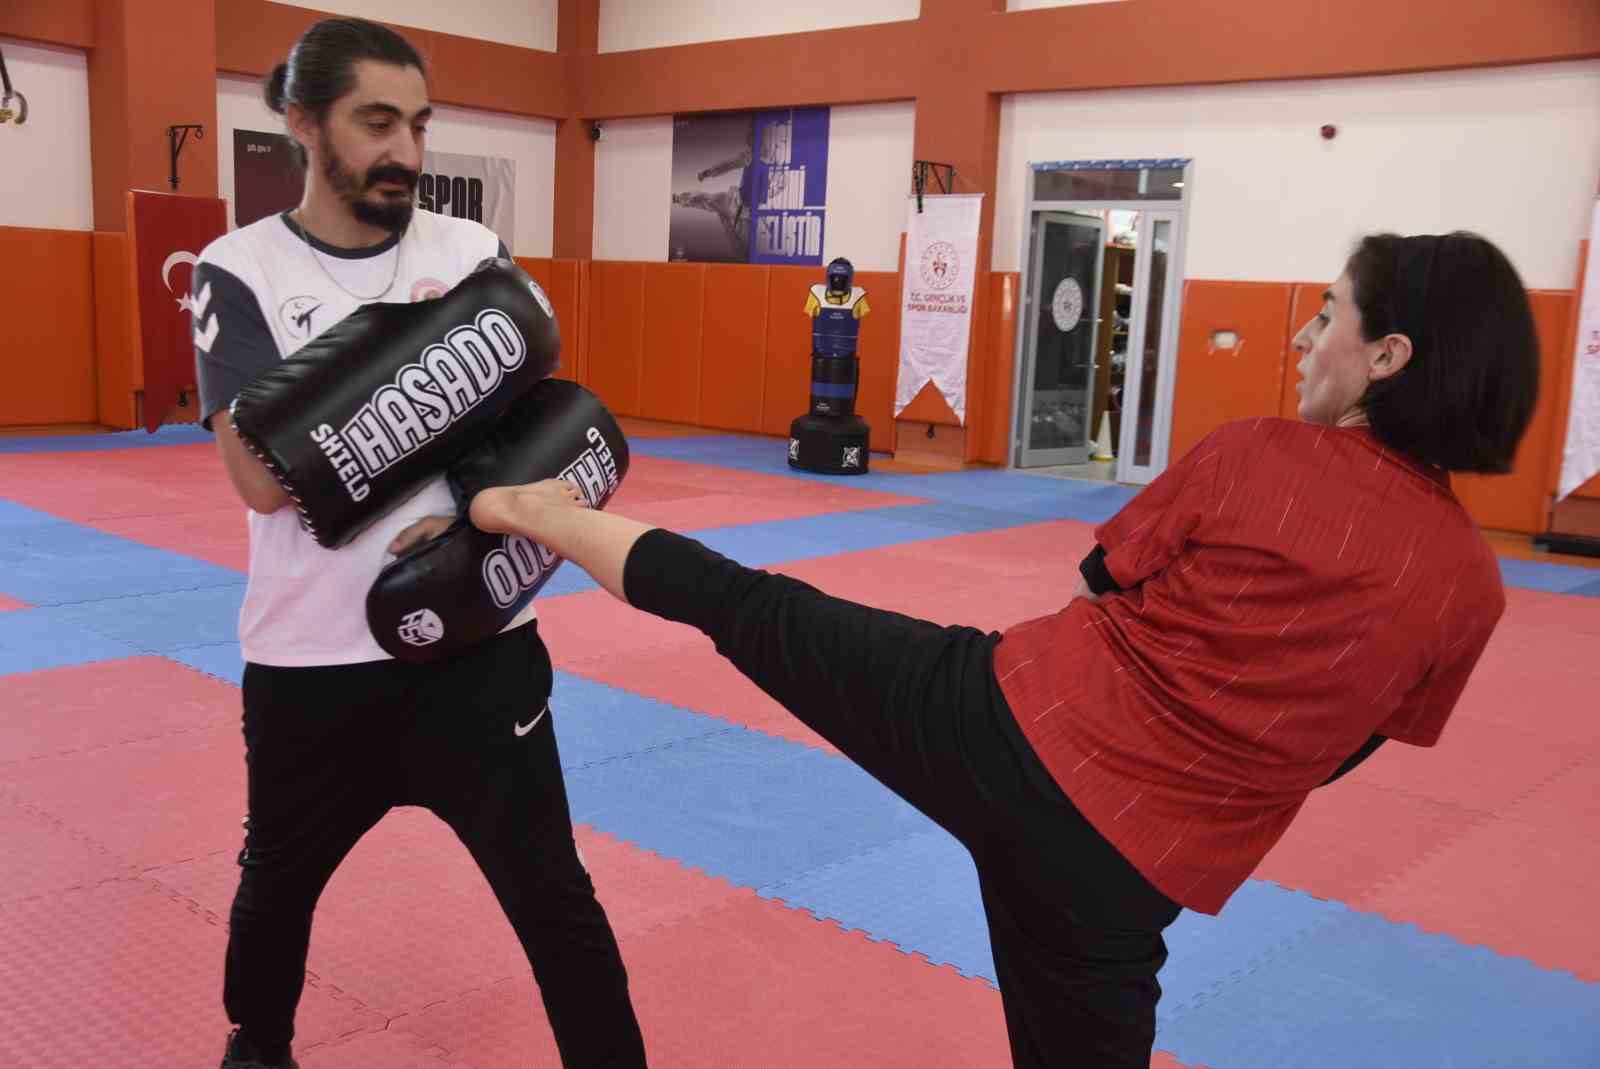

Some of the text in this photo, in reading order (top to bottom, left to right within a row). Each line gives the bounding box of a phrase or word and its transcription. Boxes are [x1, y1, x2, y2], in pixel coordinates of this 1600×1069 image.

[418, 173, 483, 225] SPOR
[340, 308, 527, 478] HASADO
[310, 423, 371, 502] SHIELD
